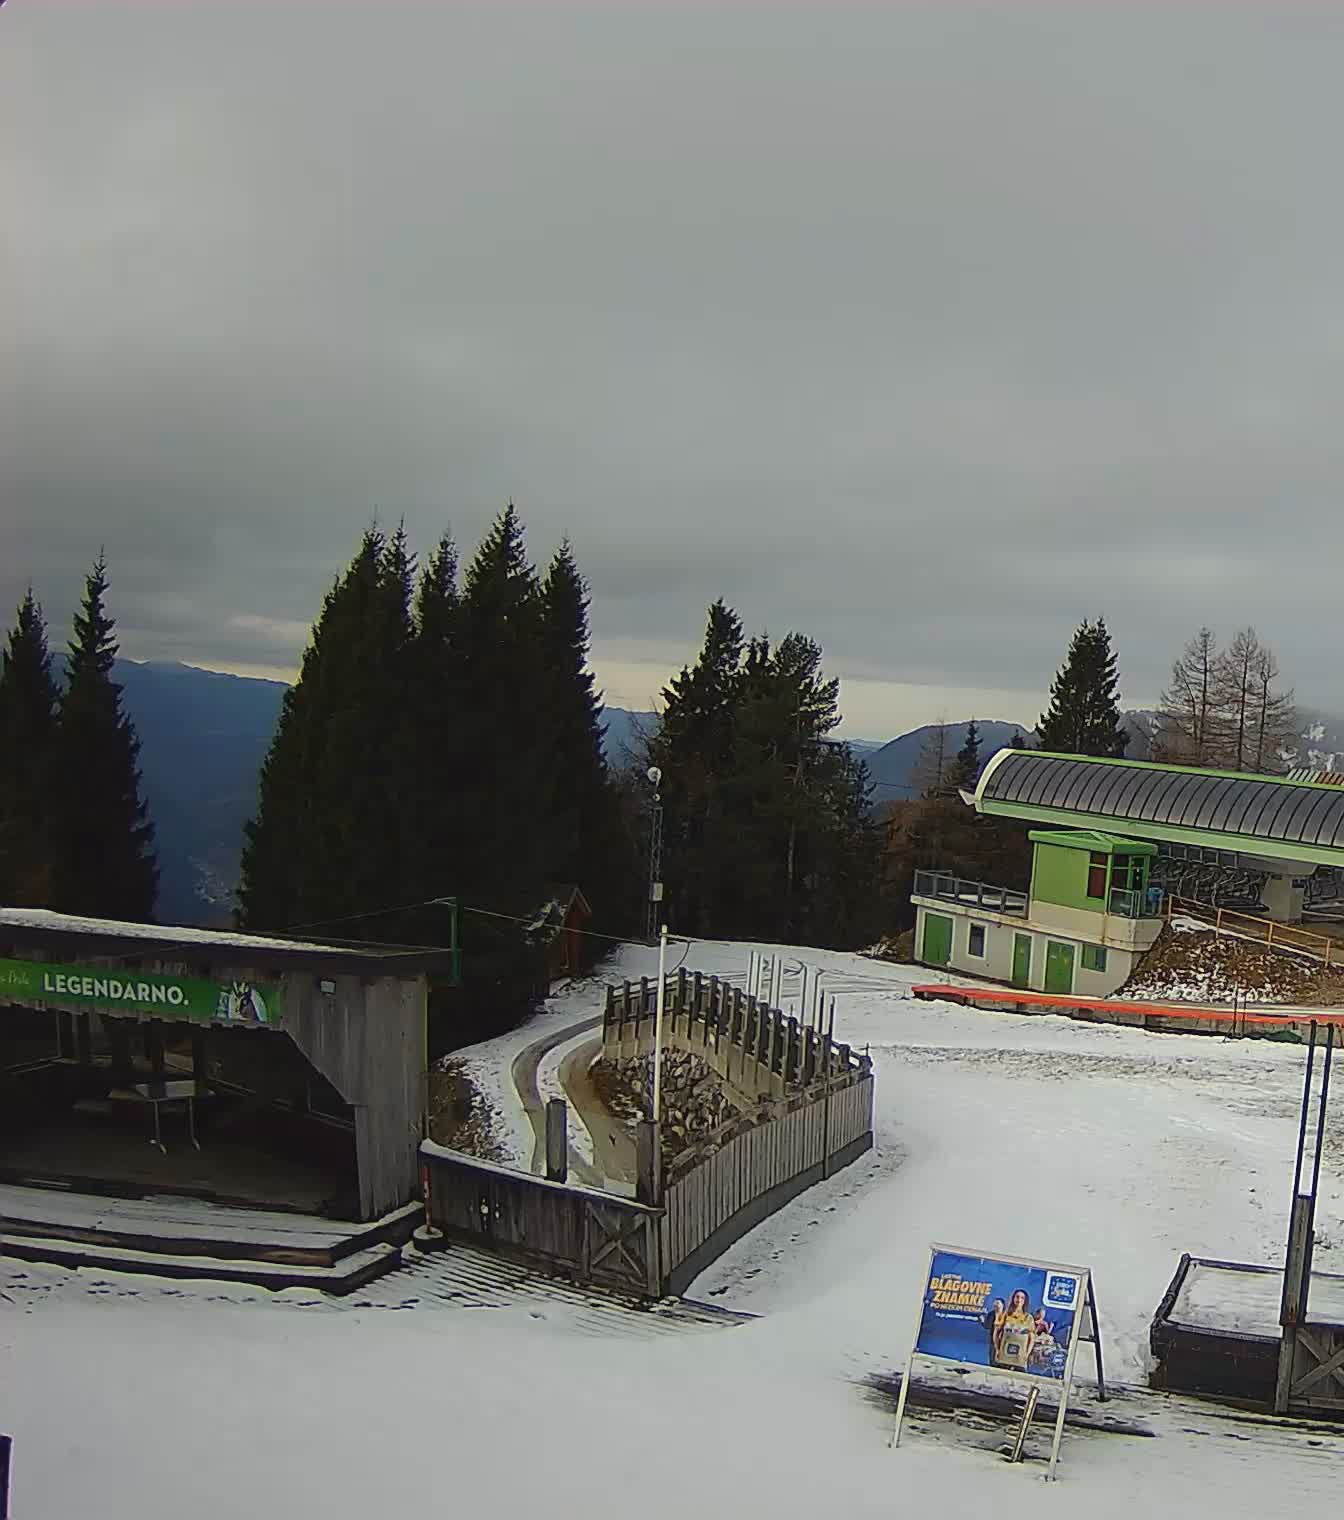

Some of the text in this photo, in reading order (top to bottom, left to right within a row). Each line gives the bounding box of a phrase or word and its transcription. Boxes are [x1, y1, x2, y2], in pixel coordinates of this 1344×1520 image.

[44, 972, 189, 1006] LEGENDARNO.
[930, 1277, 993, 1296] BLAGOVNE
[933, 1290, 985, 1307] ZNAMKE
